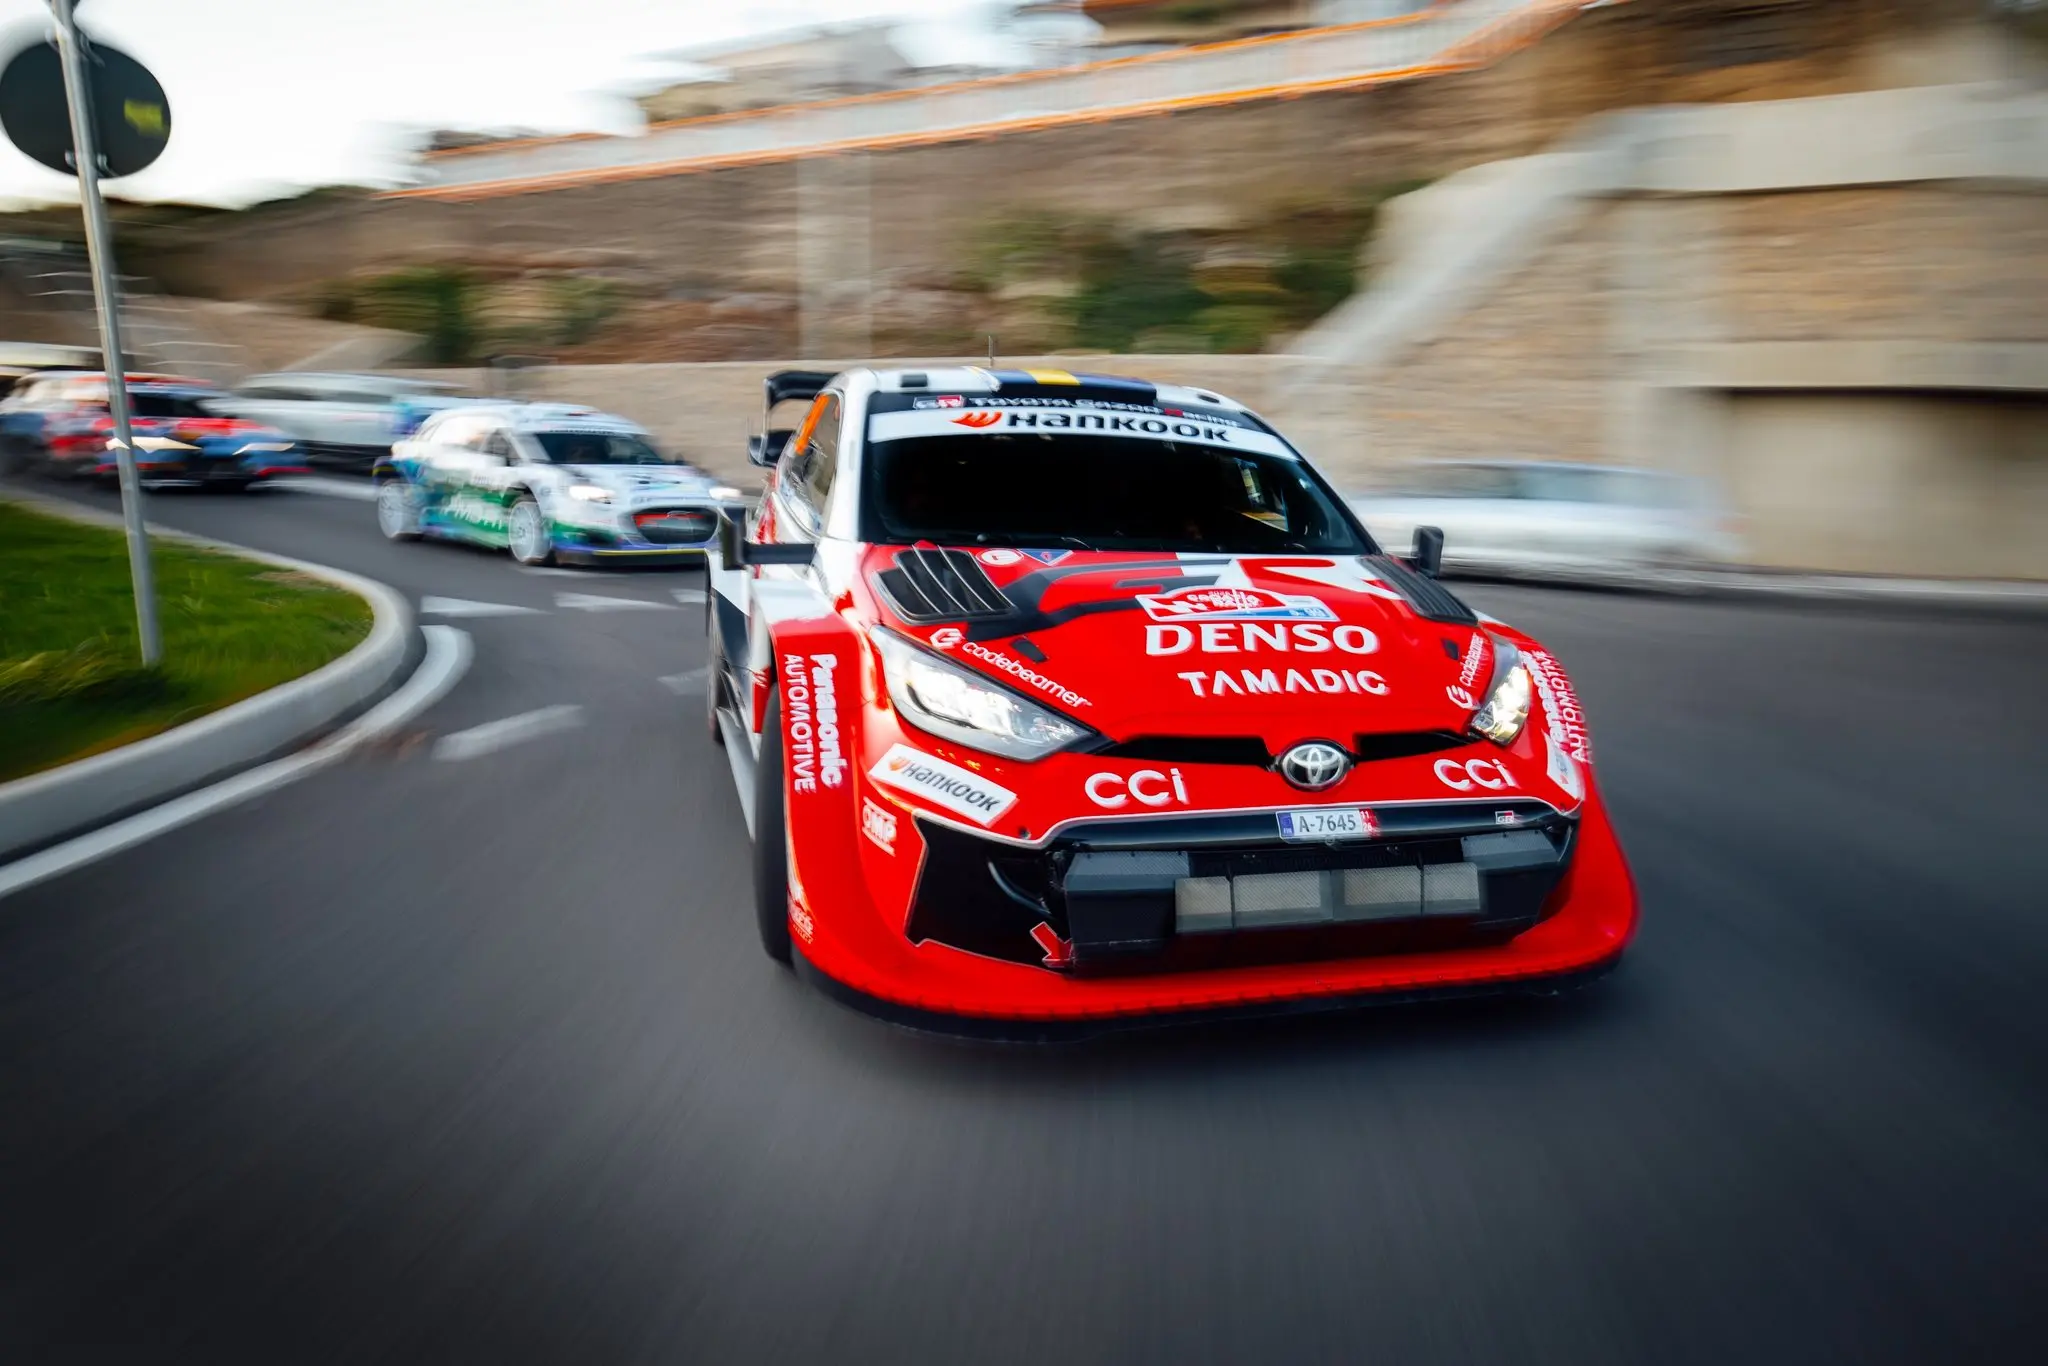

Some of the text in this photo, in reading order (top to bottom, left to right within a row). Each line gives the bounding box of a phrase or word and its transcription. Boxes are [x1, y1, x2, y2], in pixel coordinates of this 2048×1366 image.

[1144, 623, 1379, 656] DENSO
[962, 641, 1090, 707] codebeamer
[1177, 668, 1388, 698] TAMADIC
[784, 654, 816, 794] AUTOMOTIVE
[810, 653, 847, 788] Panasonic
[1299, 814, 1356, 832] A-7645
